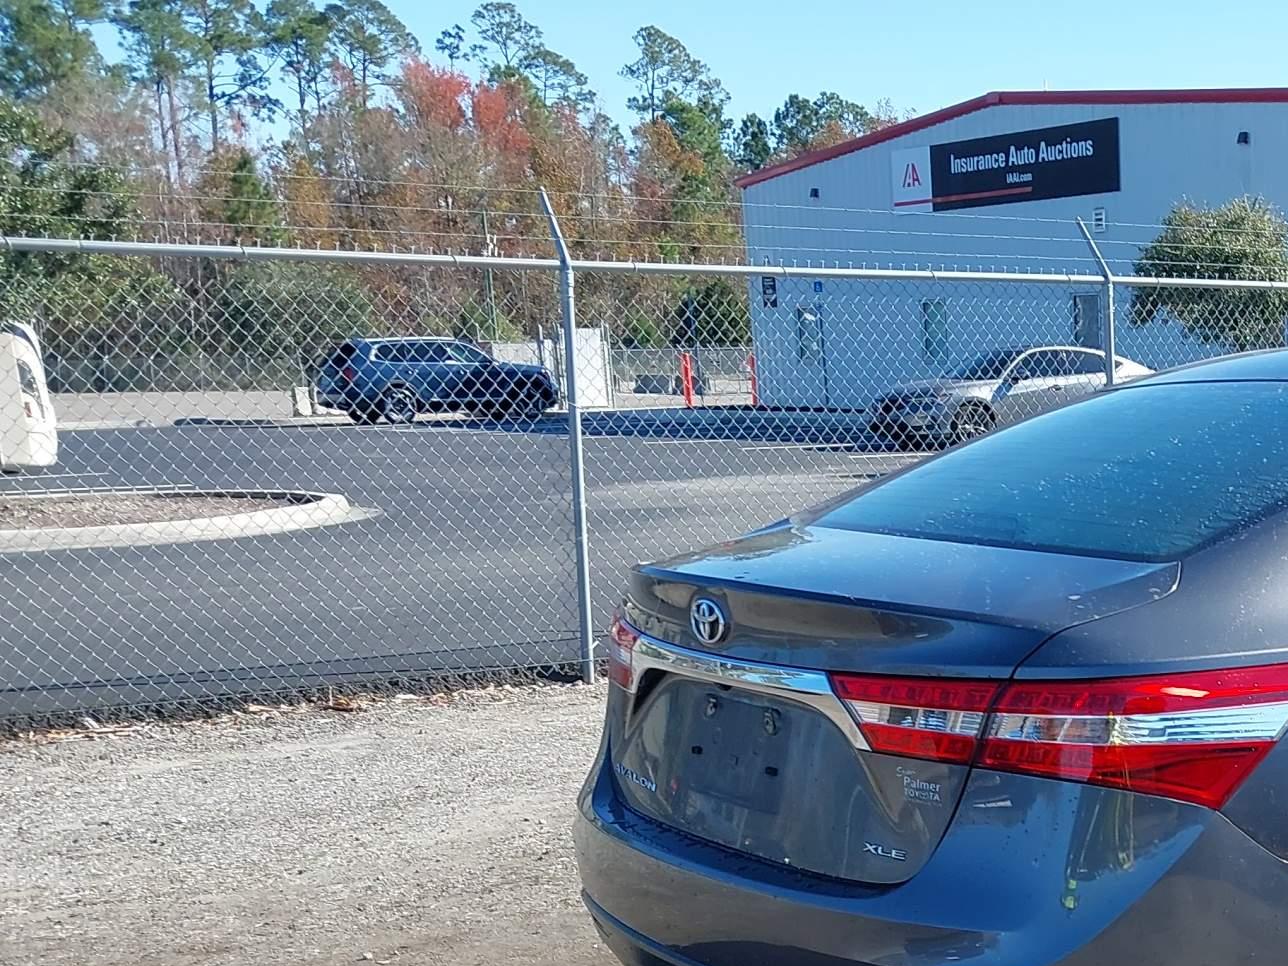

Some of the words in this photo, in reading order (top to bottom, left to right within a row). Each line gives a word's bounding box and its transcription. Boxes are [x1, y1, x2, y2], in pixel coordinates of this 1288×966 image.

[950, 151, 1006, 174] Insurance
[1008, 145, 1036, 167] Auto
[1038, 137, 1094, 164] Auctions
[615, 762, 656, 792] AVALON
[903, 775, 942, 792] Palmer
[903, 787, 941, 801] TOYOTA
[863, 842, 906, 860] XLE
